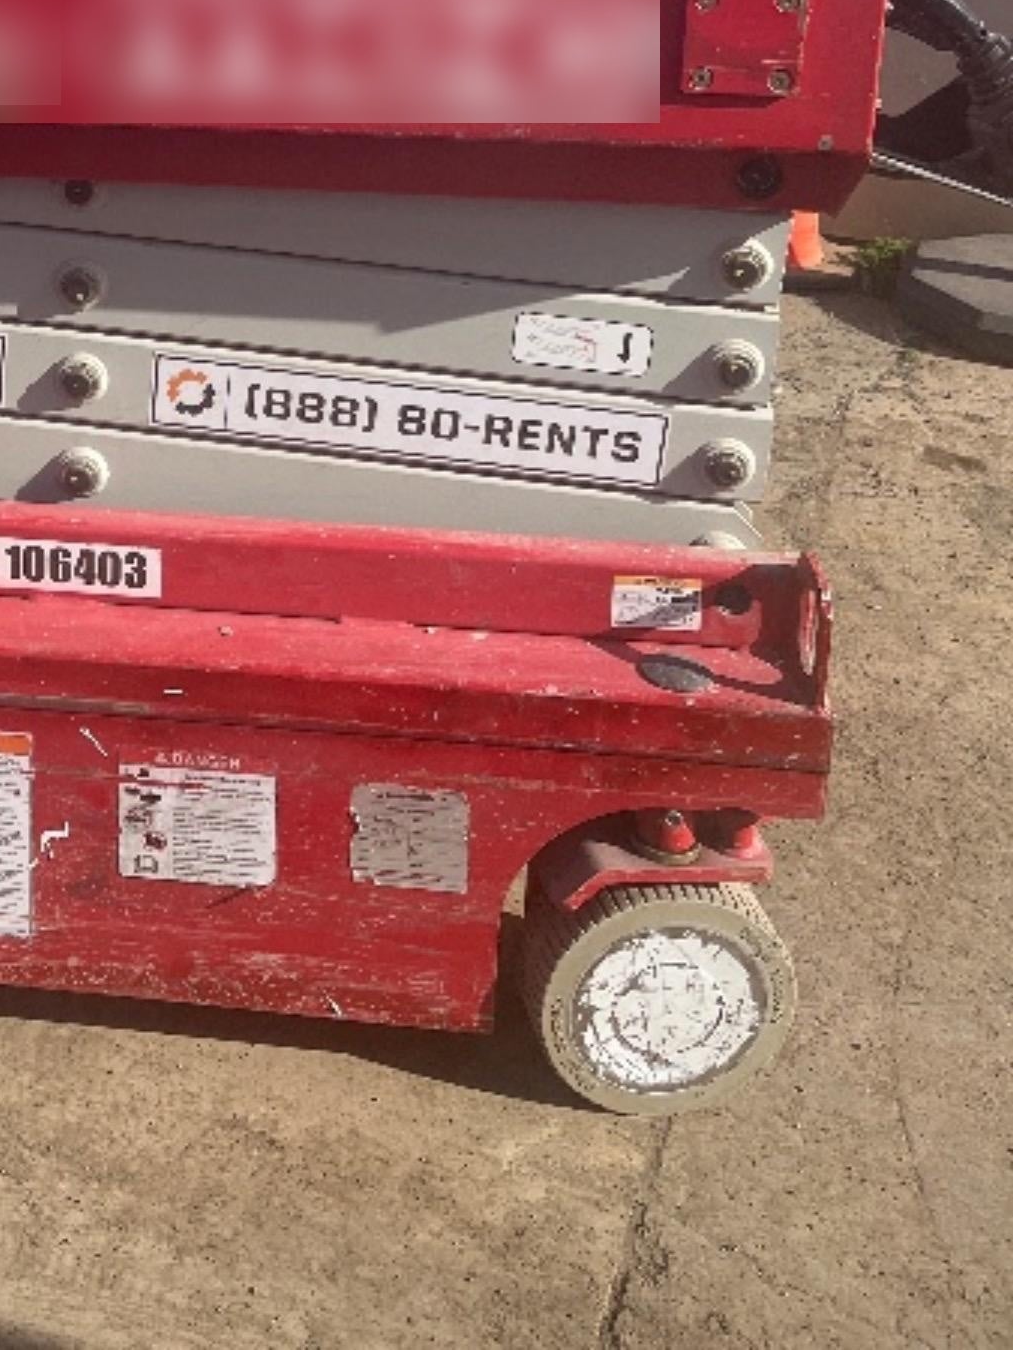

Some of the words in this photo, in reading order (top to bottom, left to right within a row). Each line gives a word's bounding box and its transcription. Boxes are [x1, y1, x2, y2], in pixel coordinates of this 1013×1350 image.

[244, 382, 378, 433] (888)
[397, 403, 642, 463] 80-RENTS
[5, 545, 148, 589] 106403
